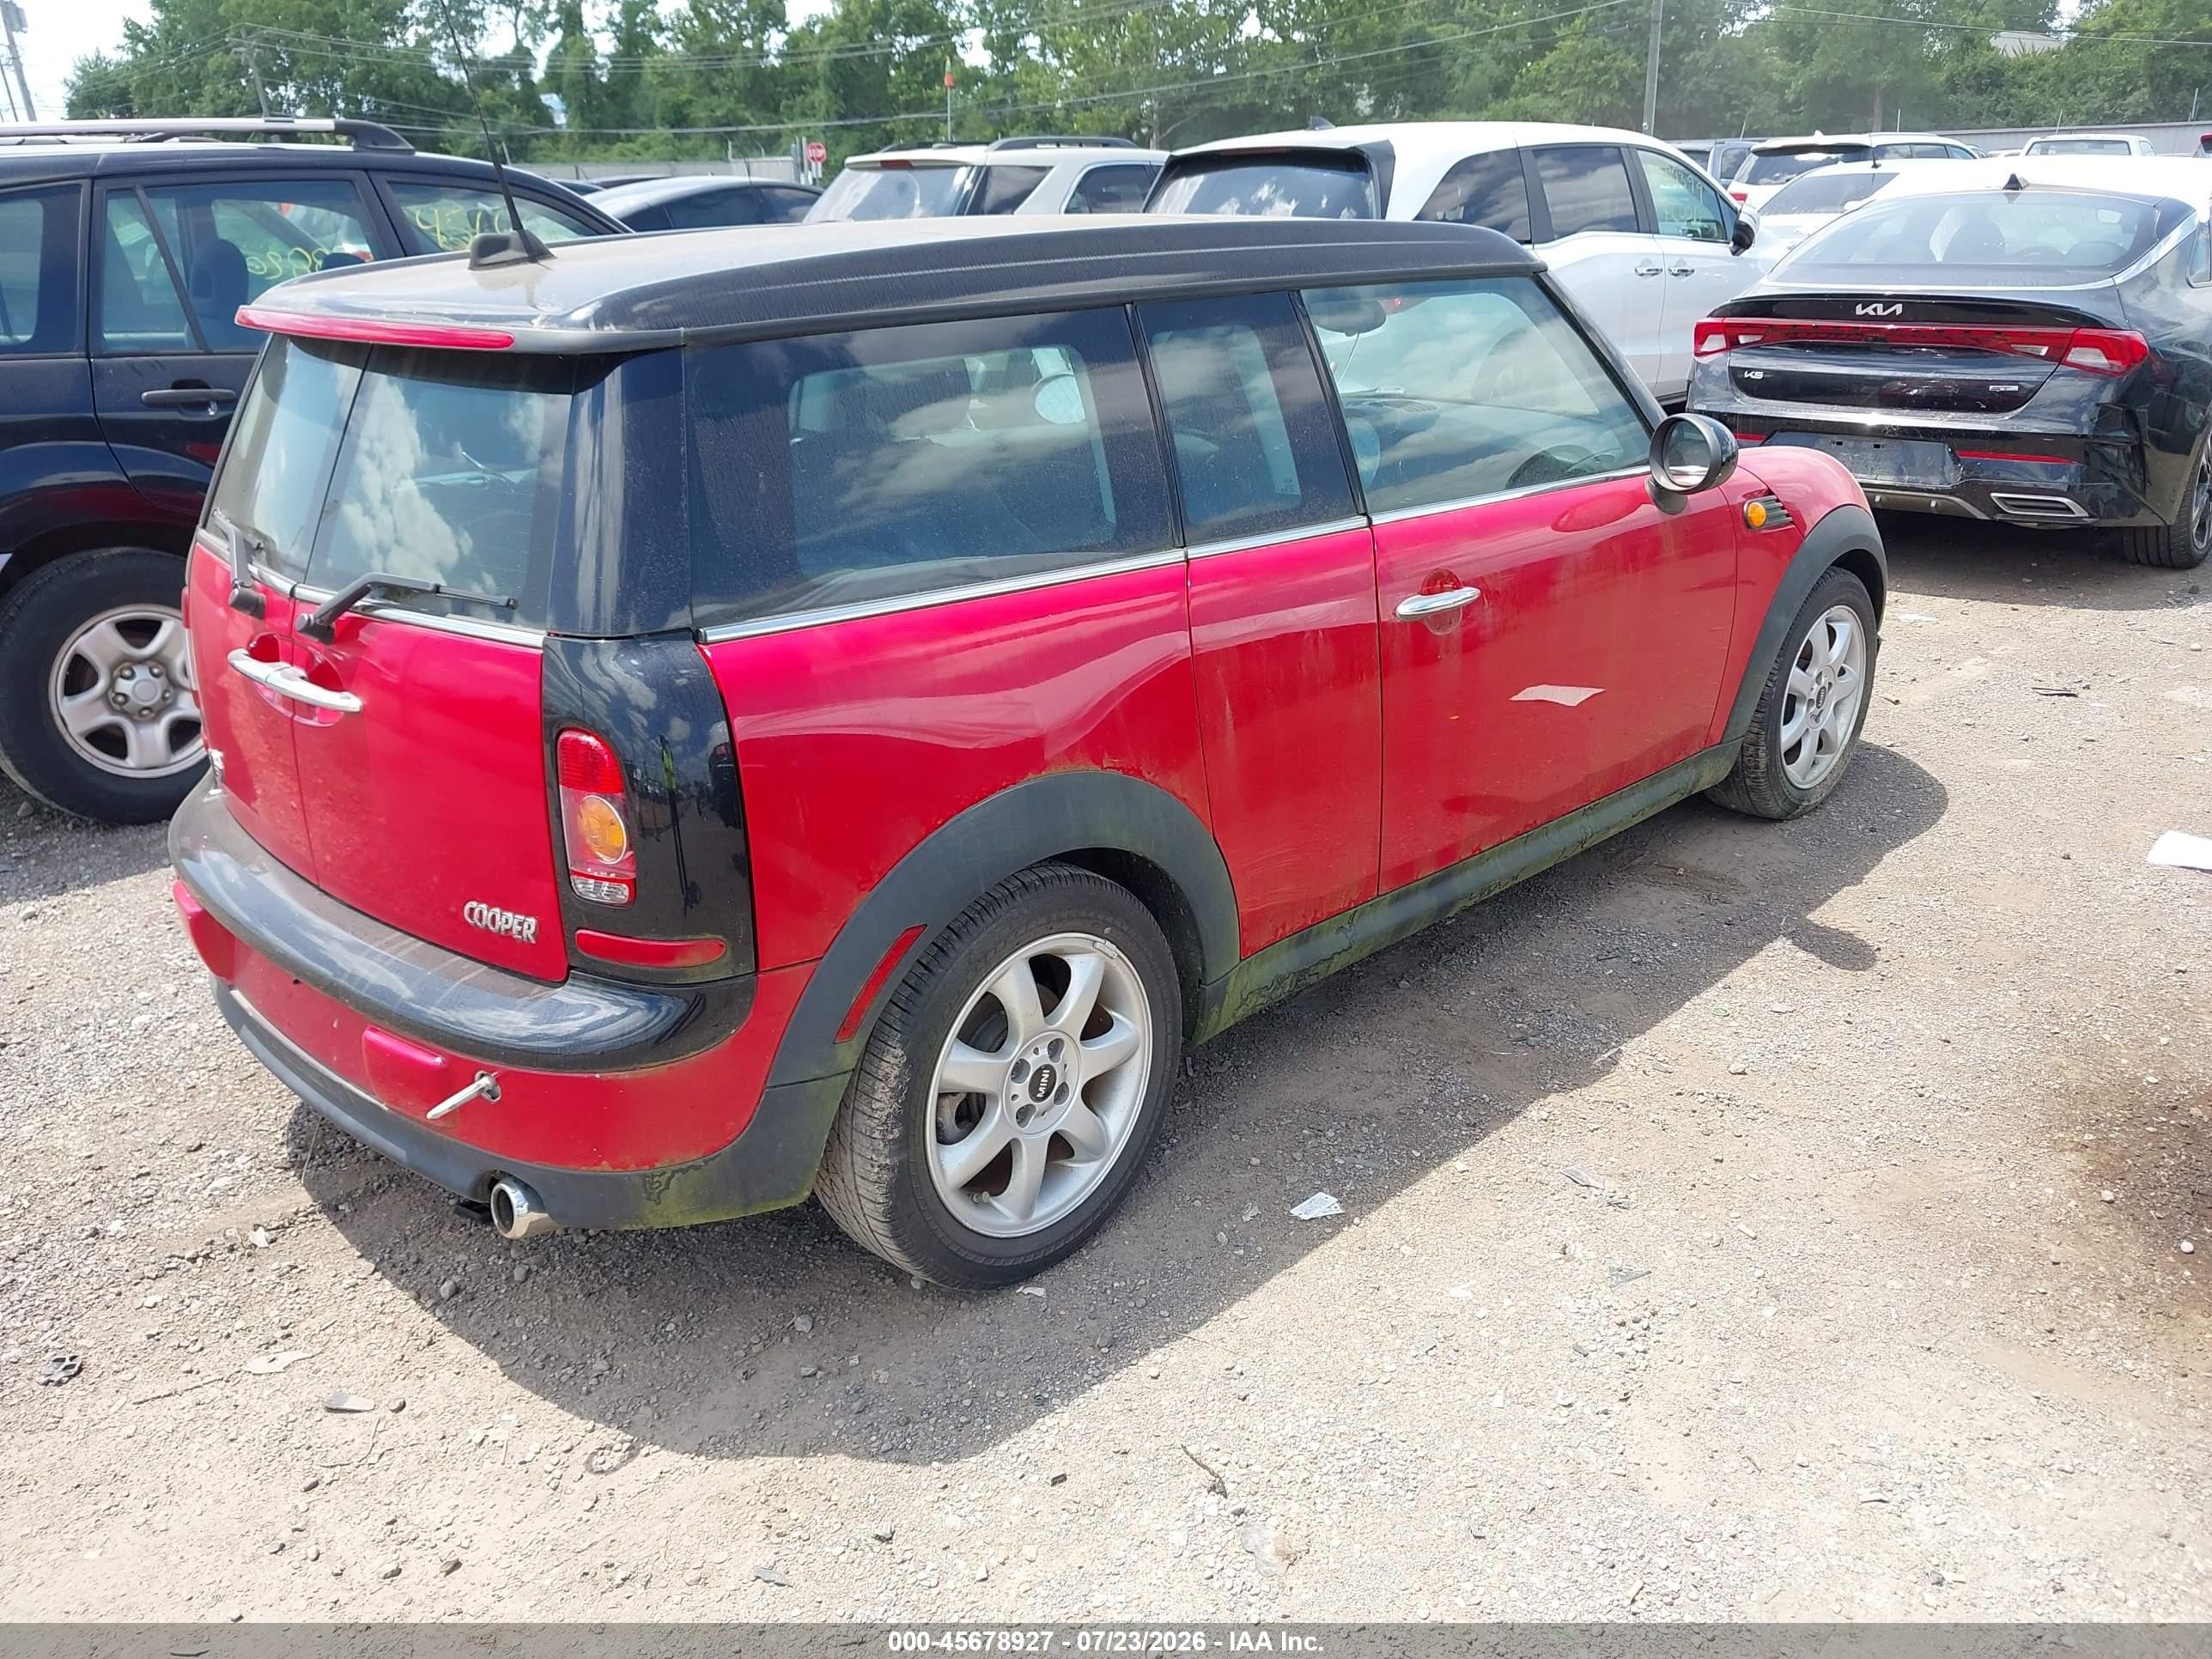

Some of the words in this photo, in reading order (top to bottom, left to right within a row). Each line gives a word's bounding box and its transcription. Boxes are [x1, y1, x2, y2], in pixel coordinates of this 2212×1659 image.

[1855, 302, 1903, 316] KIA
[1744, 370, 1764, 380] K5
[464, 901, 537, 945] COOPER
[1036, 1069, 1050, 1097] MINI
